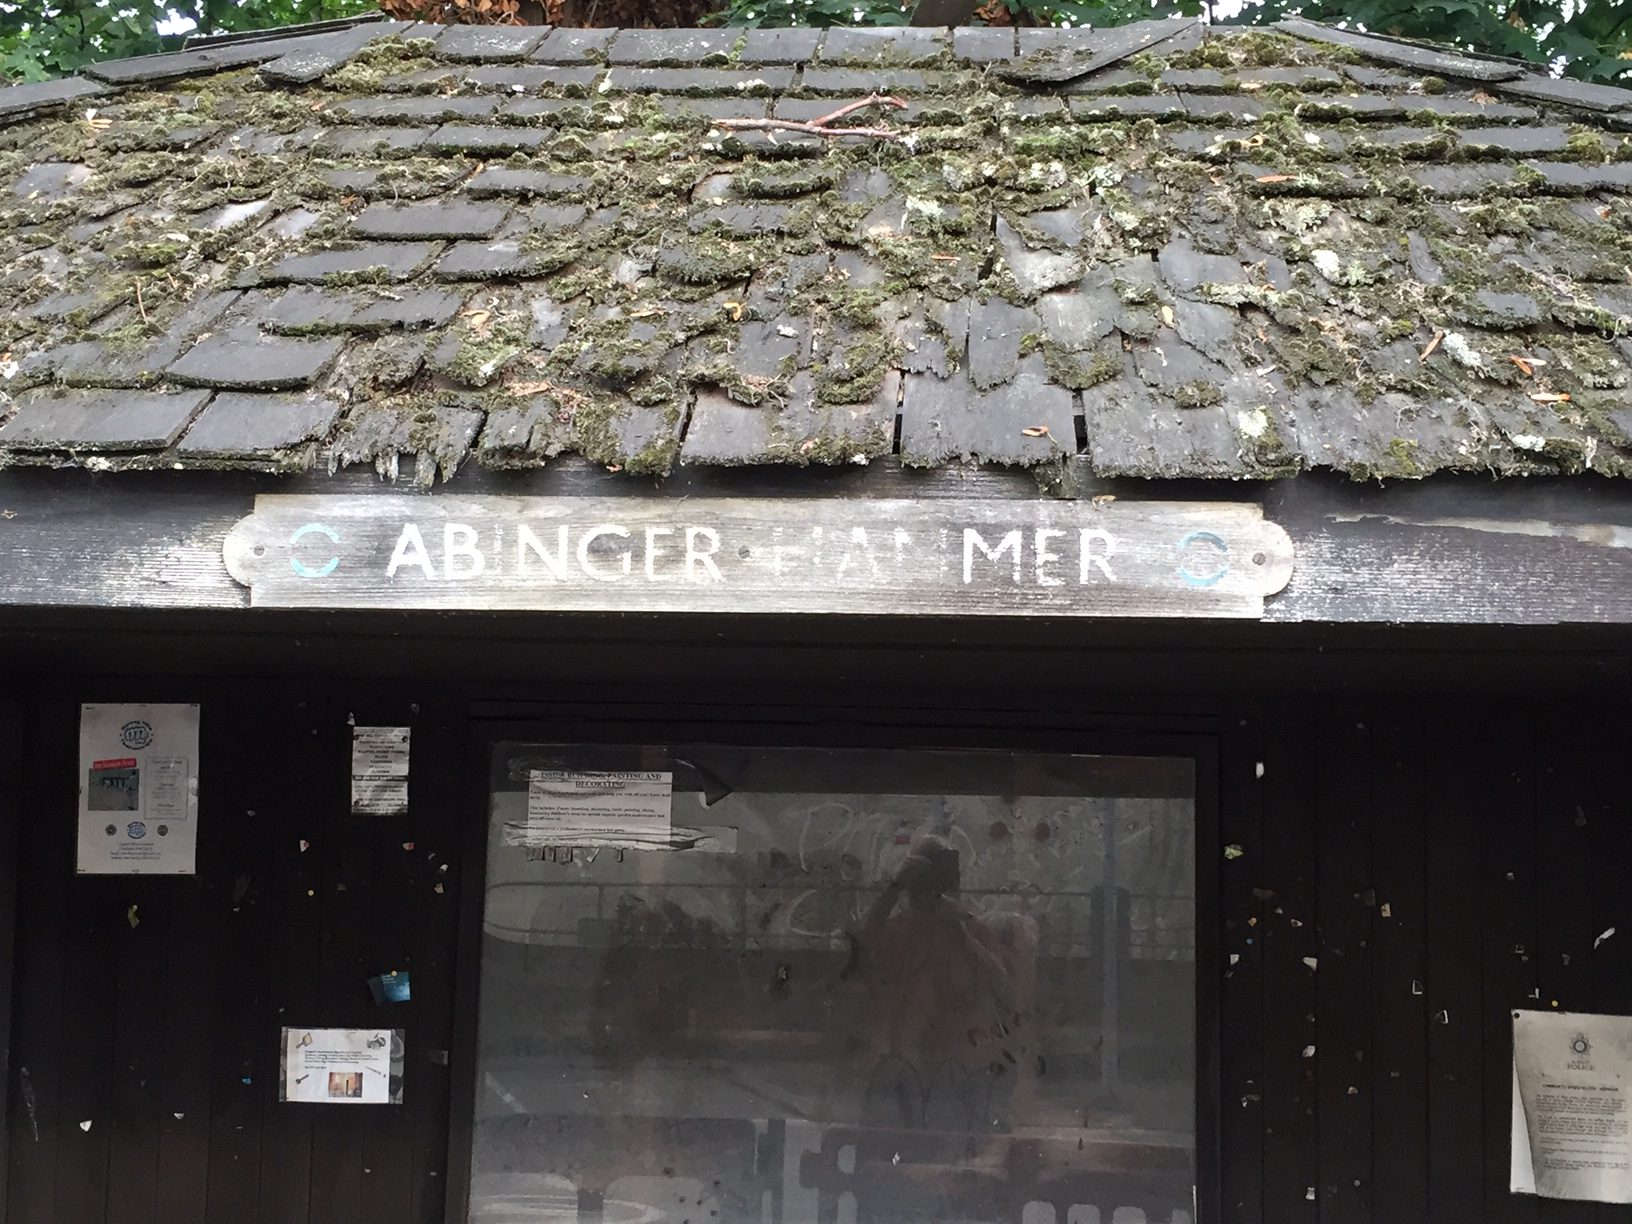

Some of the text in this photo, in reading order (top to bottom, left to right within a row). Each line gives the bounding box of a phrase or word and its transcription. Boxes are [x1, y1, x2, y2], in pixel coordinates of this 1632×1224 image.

[387, 522, 726, 584] ABINGER
[646, 773, 662, 781] AND
[575, 780, 626, 789] DECORATING
[1567, 1063, 1594, 1071] POLICE
